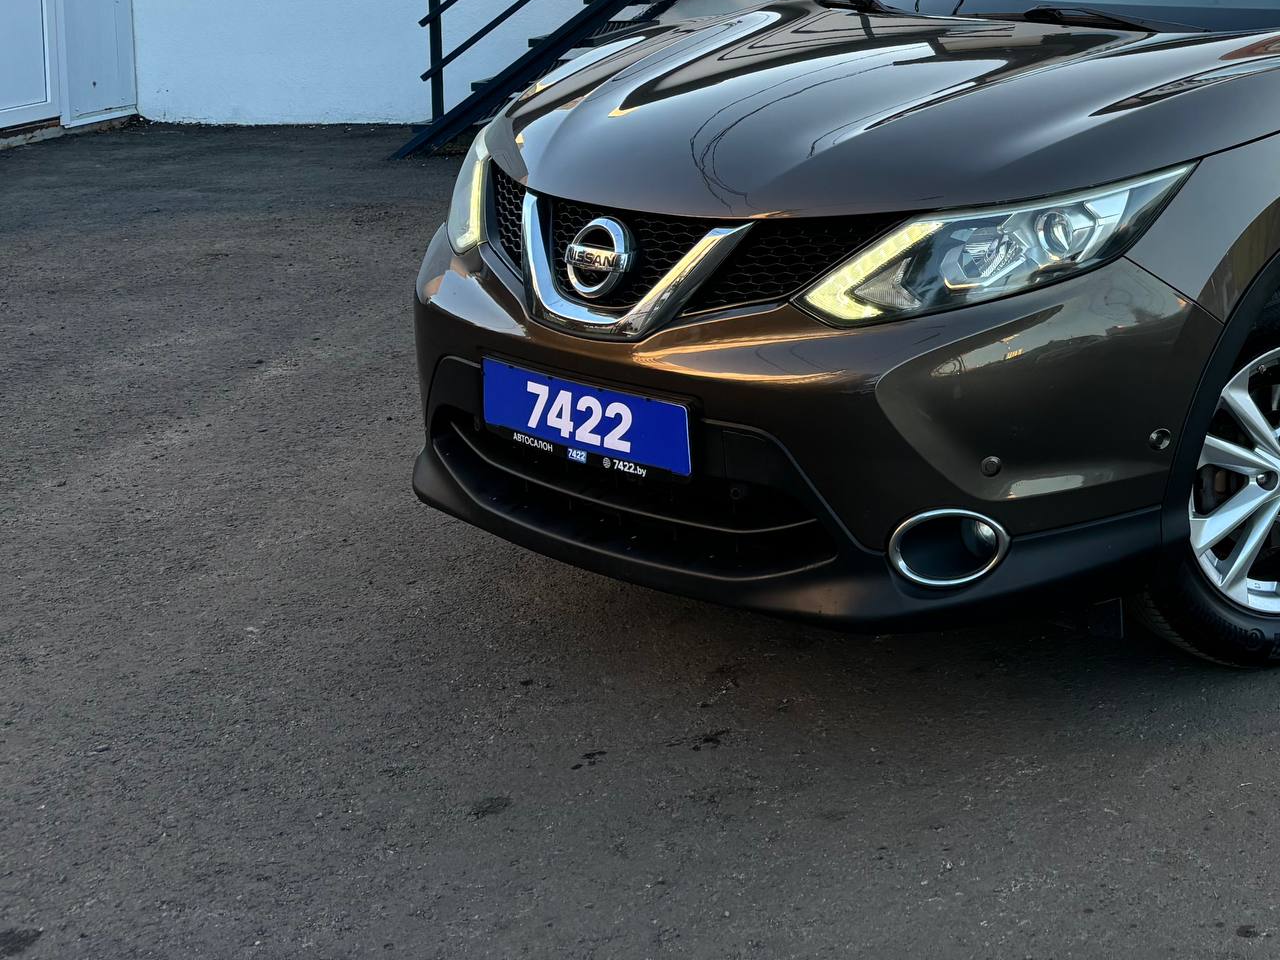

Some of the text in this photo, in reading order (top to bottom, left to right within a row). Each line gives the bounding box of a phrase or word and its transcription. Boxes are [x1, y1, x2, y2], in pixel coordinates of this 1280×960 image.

[569, 249, 618, 269] NISSAN
[526, 381, 633, 453] 7422
[513, 432, 553, 453] АВТОСАЛОН
[568, 448, 586, 461] 7422
[613, 459, 647, 477] 7422.by
